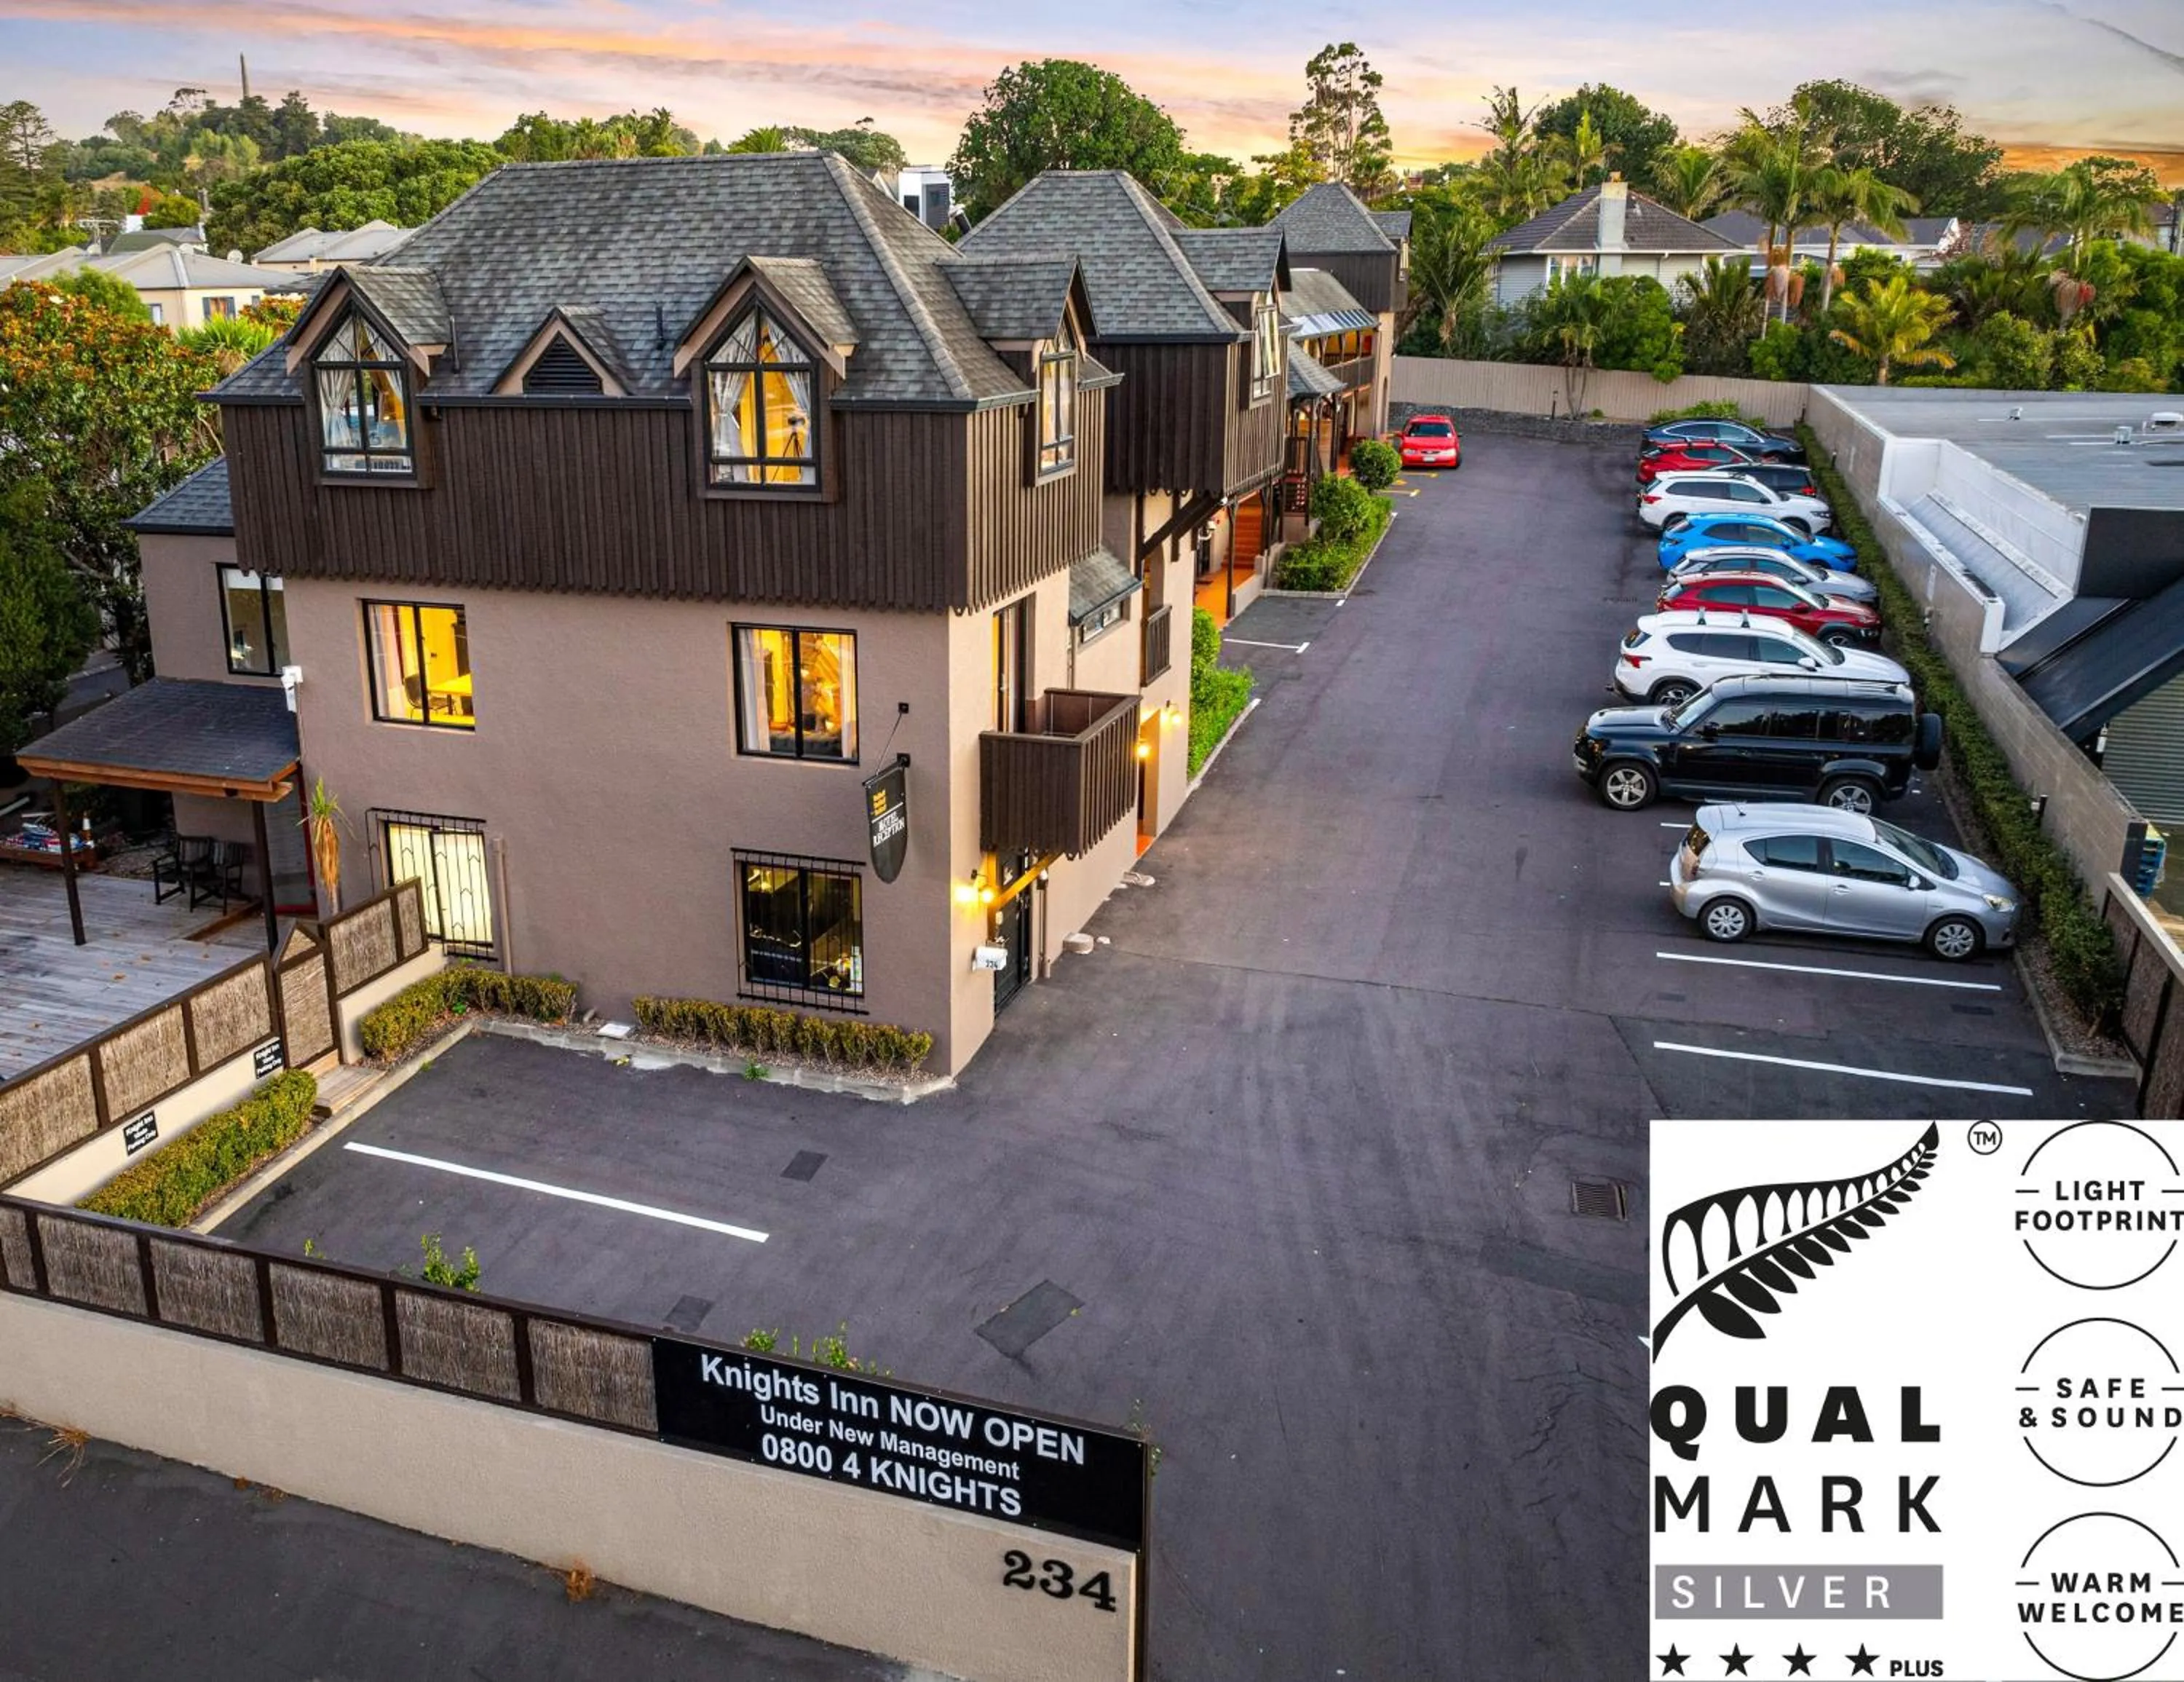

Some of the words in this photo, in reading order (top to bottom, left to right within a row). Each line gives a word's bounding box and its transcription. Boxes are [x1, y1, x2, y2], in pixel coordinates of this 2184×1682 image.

[873, 816, 905, 848] RECEPTION
[700, 1354, 820, 1406] Knights
[830, 1382, 879, 1420] Inn
[890, 1395, 973, 1440] NOW
[984, 1416, 1085, 1466] OPEN
[761, 1404, 823, 1434] Under
[828, 1419, 874, 1447] New
[879, 1430, 1020, 1481] Management
[761, 1432, 834, 1473] 0800
[842, 1451, 861, 1480] 4
[870, 1456, 1022, 1517] KNIGHTS
[1002, 1549, 1117, 1612] 234
